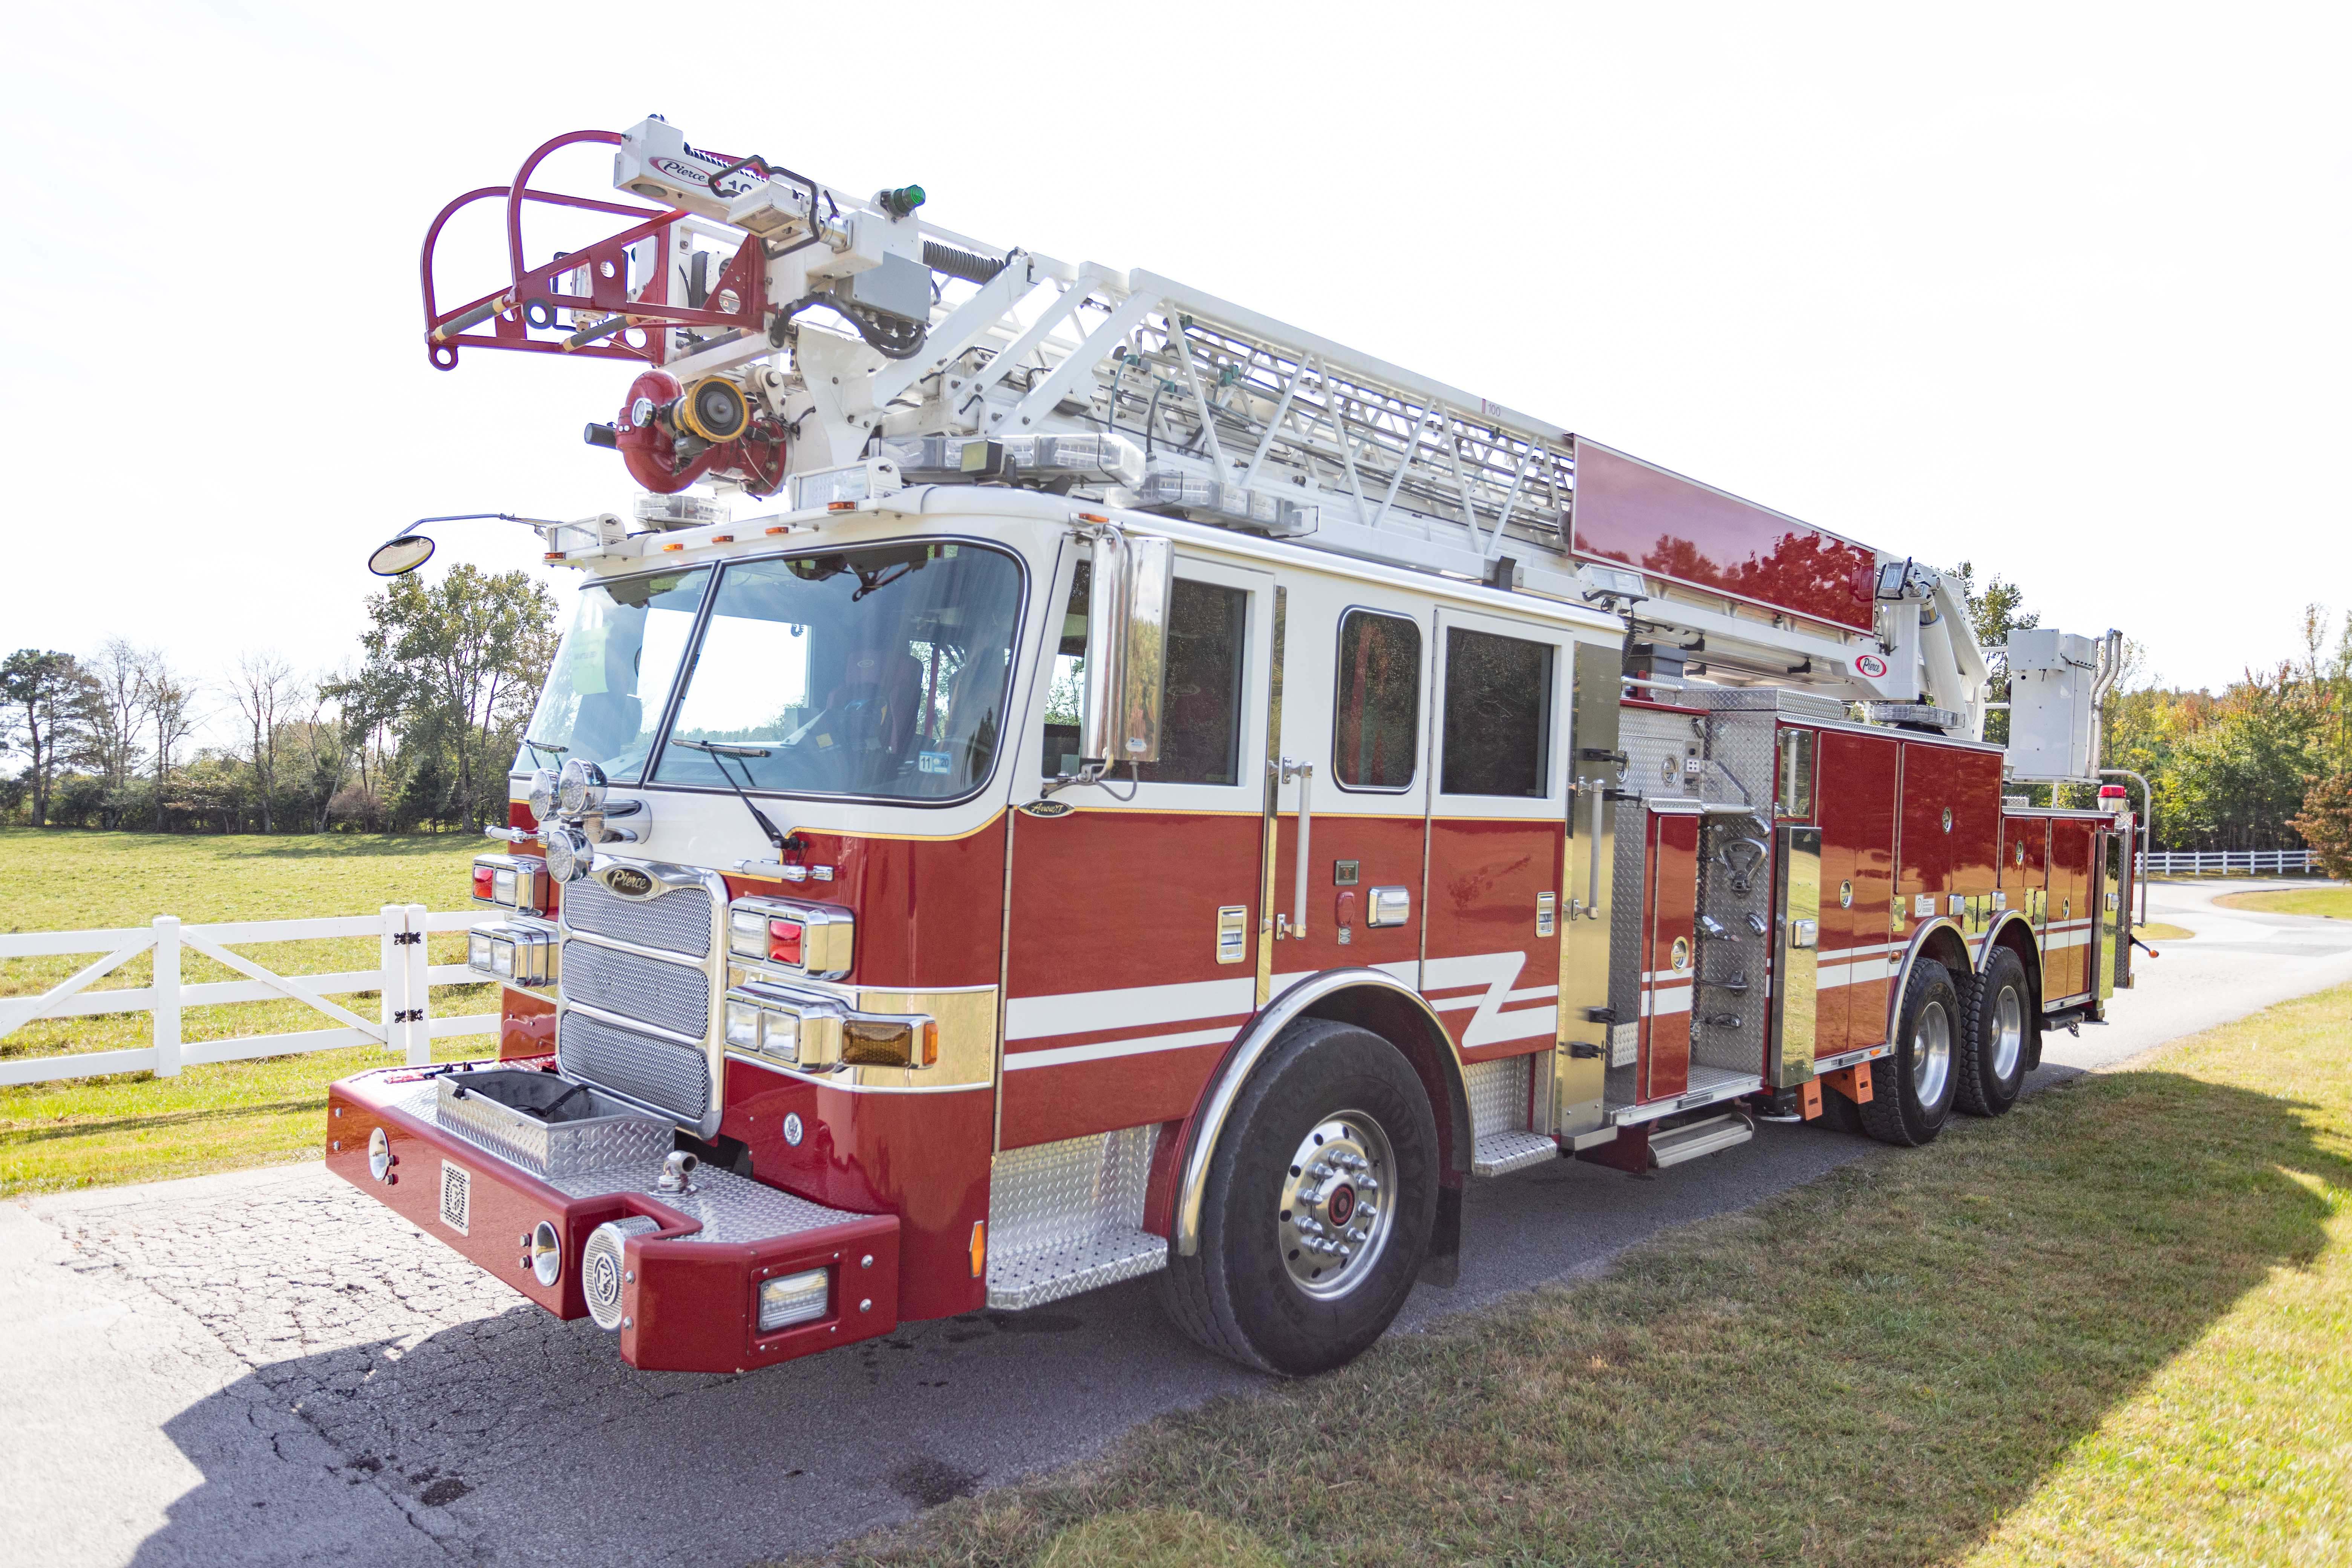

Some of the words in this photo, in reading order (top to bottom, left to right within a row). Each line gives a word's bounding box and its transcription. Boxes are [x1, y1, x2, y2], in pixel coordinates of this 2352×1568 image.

[663, 161, 706, 182] Pierce
[1488, 403, 1501, 417] 100
[1862, 658, 1880, 672] Pierce
[921, 756, 930, 769] 11
[940, 758, 949, 767] 20
[611, 869, 647, 889] Pierce
